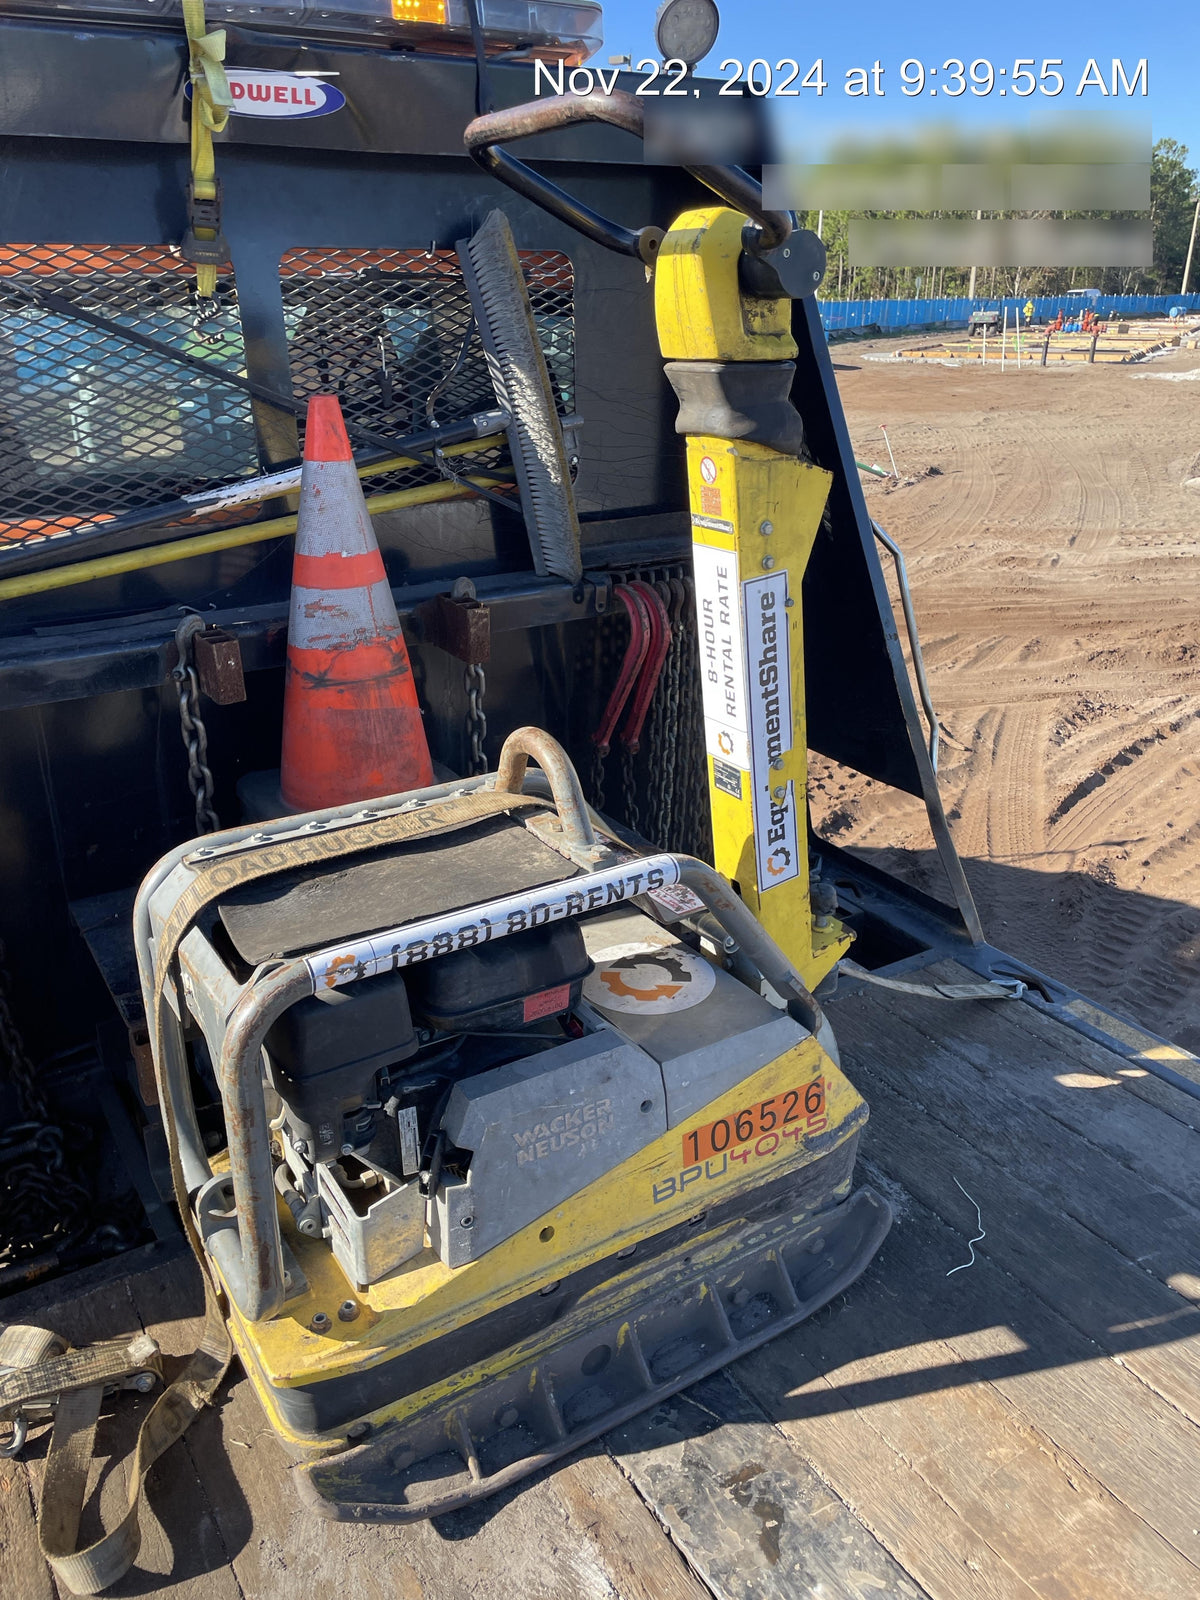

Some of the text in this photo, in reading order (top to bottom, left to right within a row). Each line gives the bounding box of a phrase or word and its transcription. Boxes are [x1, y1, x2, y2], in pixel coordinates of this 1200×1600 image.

[229, 81, 317, 106] DWELL
[702, 598, 719, 684] 8-HOUR
[716, 564, 737, 718] RENTAL RATE
[758, 591, 789, 846] EqmentShare
[390, 917, 492, 969] (888)
[505, 867, 665, 934] 80-RENTS
[512, 1098, 613, 1148] WACKER
[516, 1112, 615, 1169] NEUSON
[687, 1081, 823, 1162] 106526
